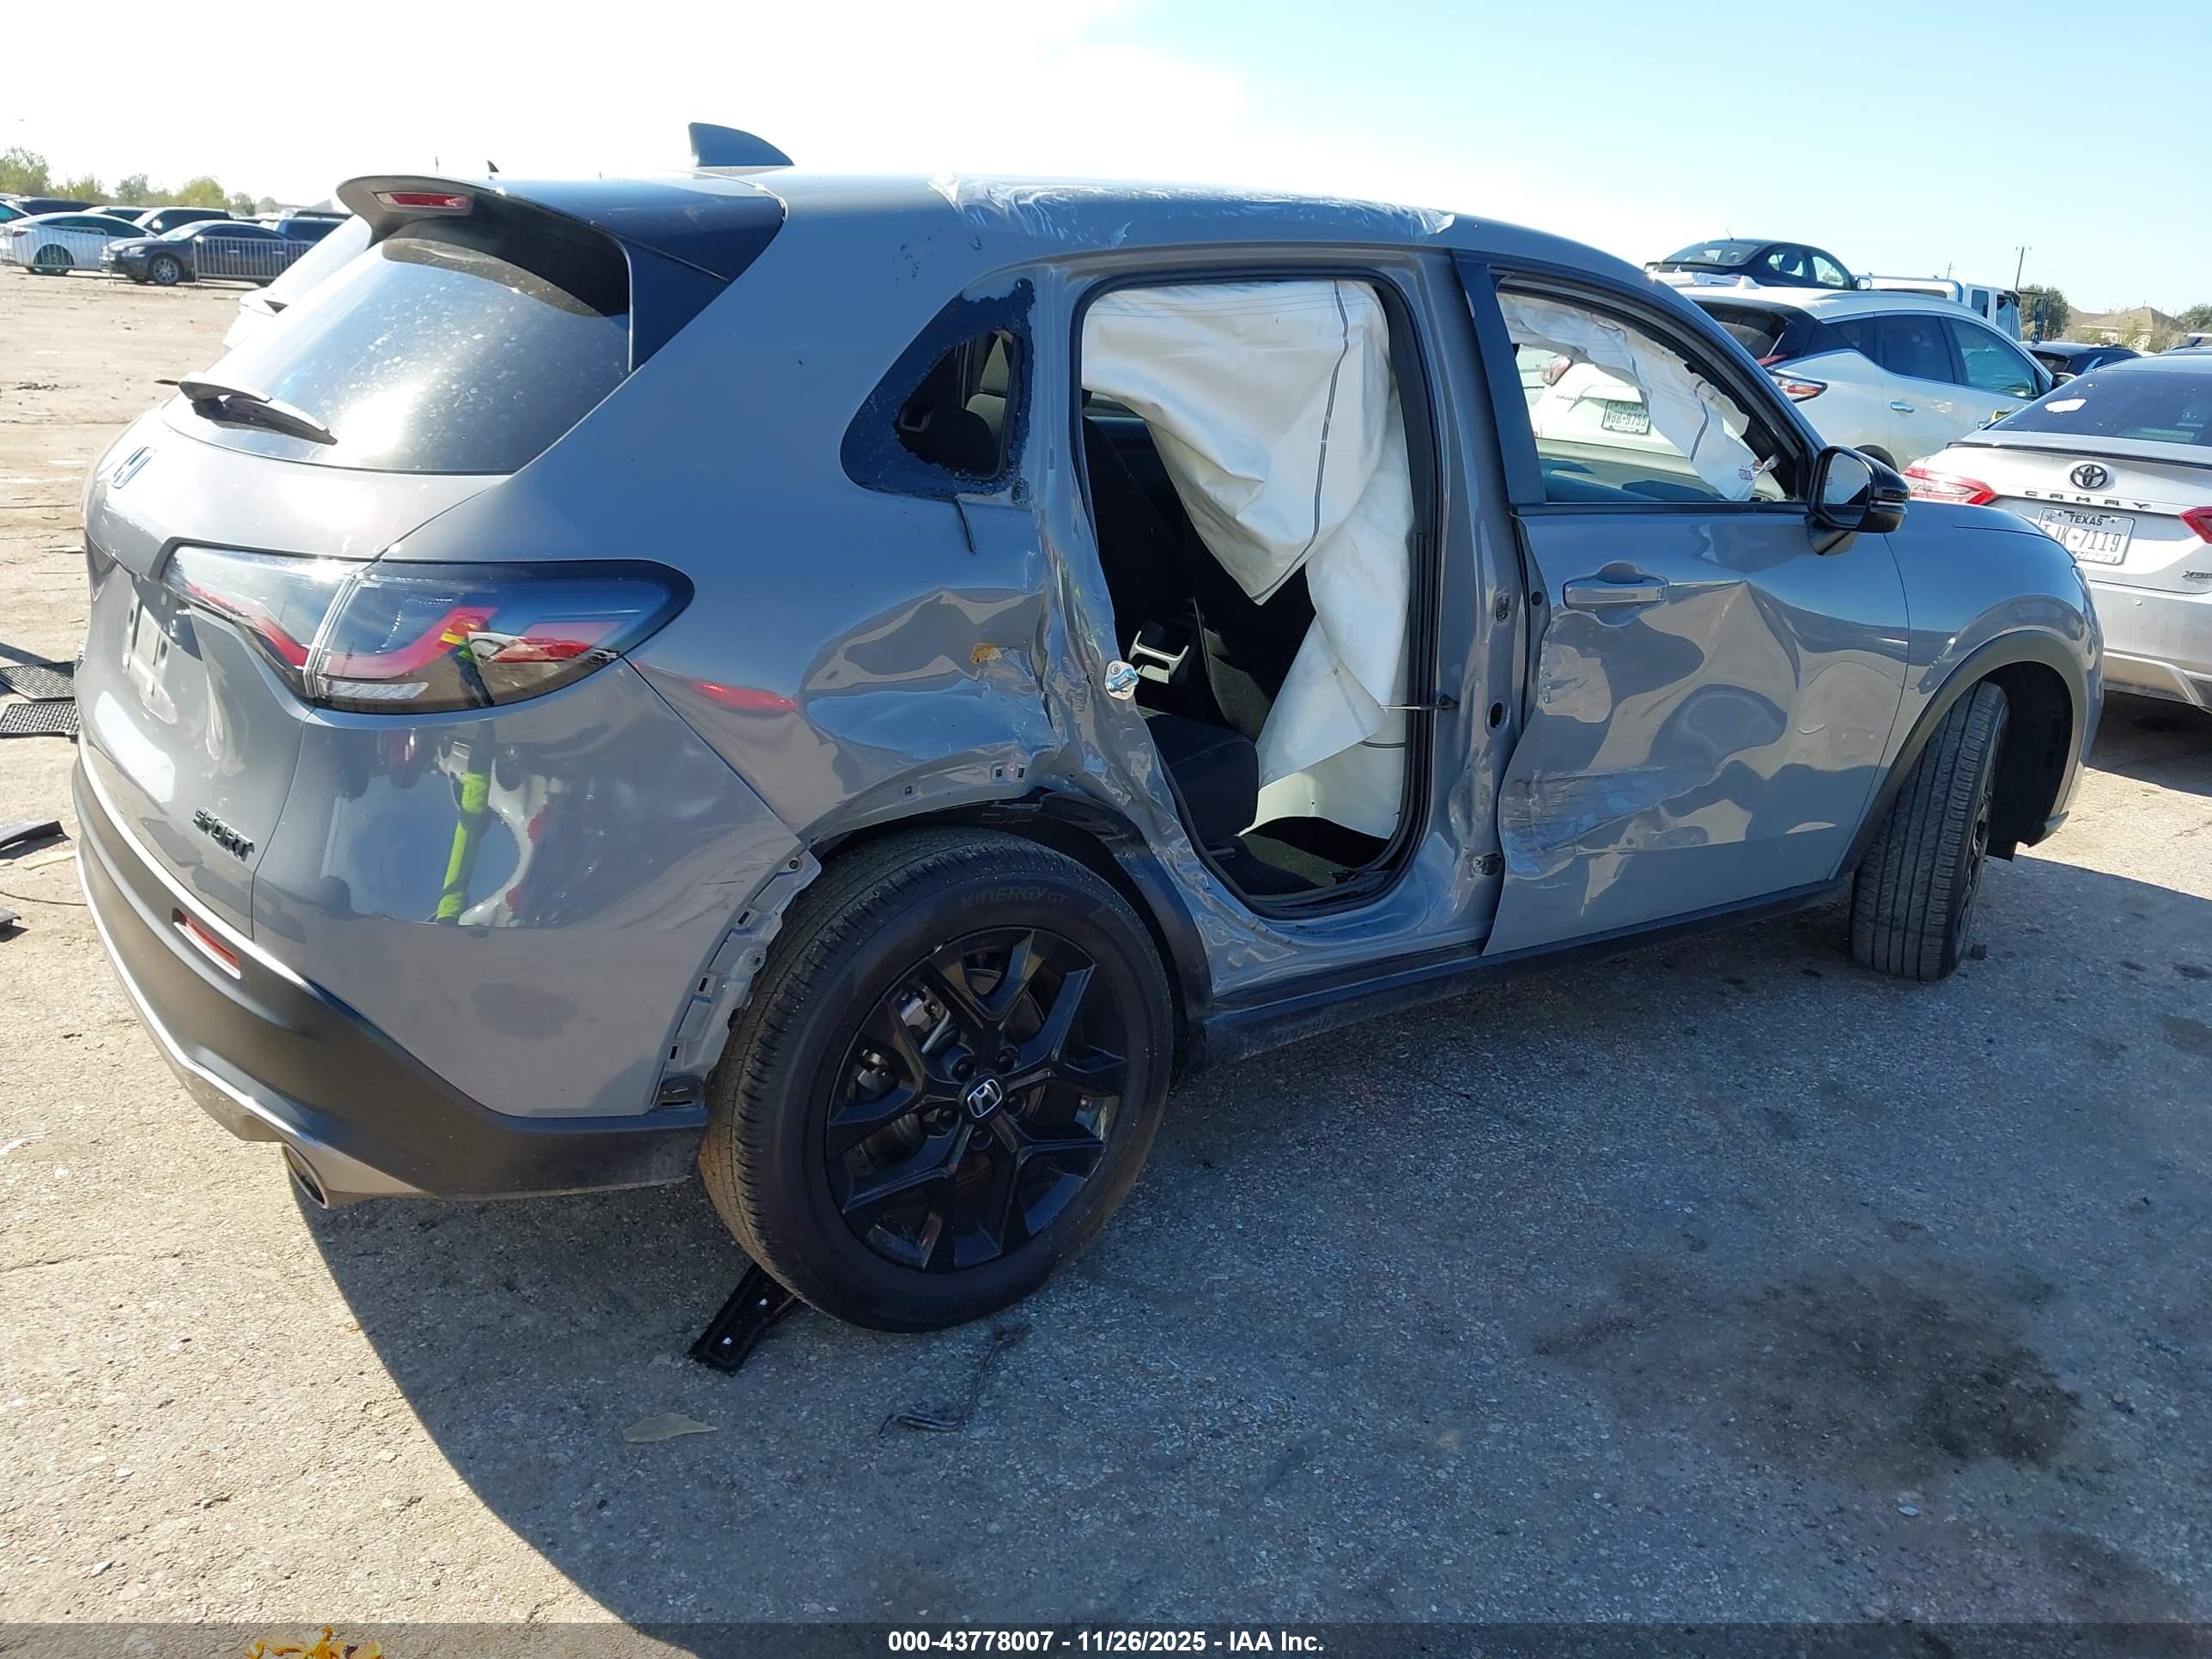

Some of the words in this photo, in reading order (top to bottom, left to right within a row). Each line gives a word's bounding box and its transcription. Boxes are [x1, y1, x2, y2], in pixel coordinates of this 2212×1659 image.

[2024, 490, 2152, 509] CAMRY
[2069, 514, 2104, 526] TEXAS
[2079, 528, 2122, 553] 7119
[192, 807, 255, 862] SPORT
